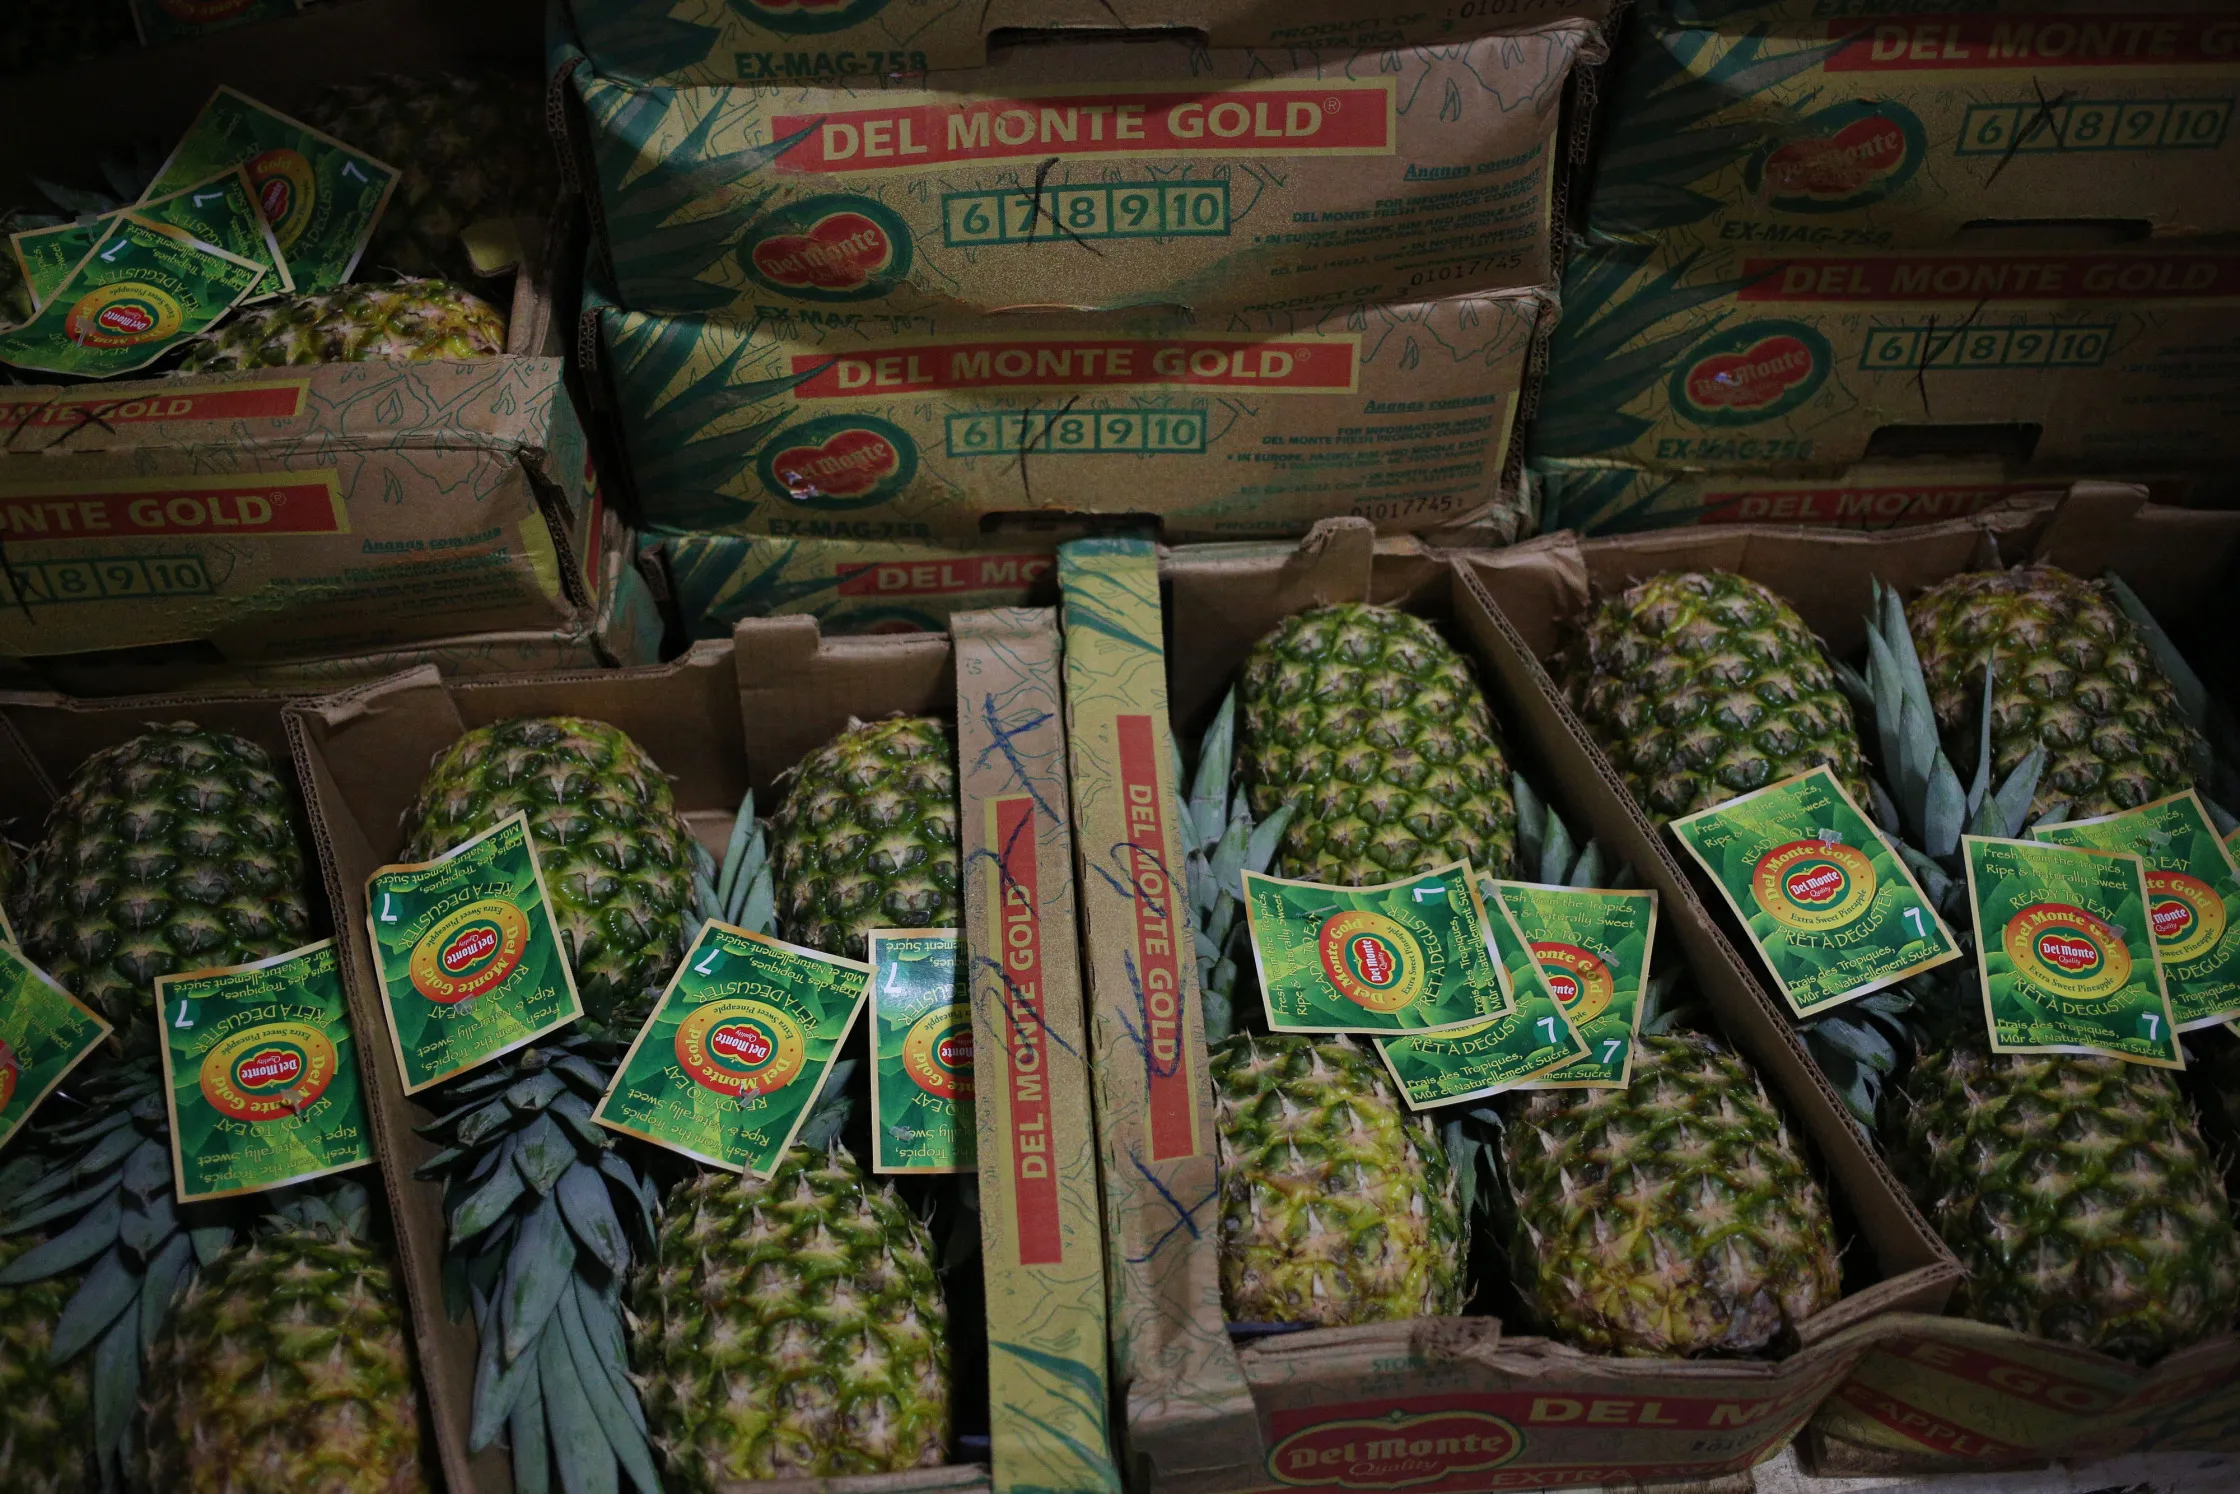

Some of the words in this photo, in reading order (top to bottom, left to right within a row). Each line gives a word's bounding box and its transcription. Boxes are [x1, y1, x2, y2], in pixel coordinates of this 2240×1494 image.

[1393, 12, 1427, 28] OF
[1870, 23, 1971, 62] DEL
[1989, 21, 2186, 58] MONTE
[735, 50, 928, 79] EX-MAG-758
[822, 118, 929, 161] DEL
[947, 103, 1146, 151] MONTE
[1978, 114, 2001, 143] 6
[2075, 112, 2102, 139] 8
[2128, 111, 2157, 140] 9
[2176, 109, 2220, 138] 10
[256, 156, 293, 175] Gold
[342, 161, 369, 184] 7
[1403, 163, 1472, 181] Ananas
[192, 191, 224, 209] 7
[962, 203, 990, 234] 6
[1015, 199, 1040, 231] 7
[1069, 196, 1097, 228] 8
[1119, 193, 1149, 226] 9
[1172, 192, 1219, 225] 10
[100, 239, 128, 262] 7
[1410, 254, 1522, 286] 01017745
[1782, 262, 1872, 295] DEL
[1890, 260, 2068, 293] MONTE
[2081, 258, 2219, 291] GOLD
[1879, 336, 1904, 362] 6
[1970, 335, 1996, 361] 8
[2016, 334, 2043, 360] 9
[2060, 334, 2102, 360] 10
[837, 355, 933, 390] DEL
[951, 347, 1135, 380] MONTE
[92, 399, 194, 420] GOLD
[1364, 400, 1425, 414] Ananas
[963, 419, 989, 447] 6
[1012, 419, 1034, 445] 7
[1059, 419, 1085, 445] 8
[1106, 419, 1133, 444] 9
[1154, 418, 1198, 445] 10
[816, 443, 888, 476] Monte
[1738, 494, 1822, 519] DEL
[362, 538, 425, 554] Ananas
[57, 568, 88, 594] 8
[106, 565, 135, 590] 9
[155, 564, 201, 589] 10
[877, 565, 965, 590] DEL
[1127, 784, 1154, 837] DEL
[1704, 833, 1733, 850] Ripe
[1795, 796, 1832, 814] Sweet
[2137, 809, 2185, 829] Tropics,
[424, 843, 487, 882] Naturellement
[1766, 844, 1815, 874] Monte
[1818, 842, 1862, 871] Gold
[2078, 860, 2126, 876] Tropics,
[375, 870, 424, 888] Sucré
[418, 866, 477, 894] Tropiques,
[1762, 873, 1780, 902] Del
[1790, 879, 1808, 896] Del
[1806, 869, 1840, 892] Monte
[2091, 877, 2129, 891] Sweet
[380, 892, 398, 922] 7
[1136, 845, 1171, 959] MONTE
[1413, 886, 1446, 903] 7
[1588, 897, 1637, 916] Tropics,
[2170, 877, 2214, 910] Gold
[1008, 883, 1034, 961] GOLD
[1331, 916, 1365, 941] Gold
[1596, 917, 1636, 929] Sweet
[1834, 886, 1893, 949] DEGUSTER
[1903, 906, 1927, 937] 7
[2015, 922, 2031, 949] Del
[2028, 909, 2086, 928] Monte
[502, 924, 519, 956] Del
[715, 931, 754, 950] Sucré
[754, 942, 834, 976] Naturellement
[885, 942, 924, 952] Sucré
[1361, 939, 1377, 968] Monte
[2042, 943, 2062, 955] Del
[2062, 944, 2096, 960] Monte
[694, 948, 720, 975] 7
[748, 957, 805, 984] Tropiques,
[1326, 942, 1356, 989] Monte
[1836, 945, 1896, 973] Tropiques,
[2058, 954, 2082, 966] Quality
[172, 978, 227, 993] Sucré
[229, 962, 297, 989] Naturellement
[418, 966, 455, 997] Gold
[457, 955, 510, 994] Monte
[884, 961, 902, 994] 7
[1796, 988, 1822, 1005] Mûr
[1834, 957, 1908, 991] Naturellement
[1908, 942, 1942, 963] Sucré
[219, 983, 286, 1001] Tropiques,
[526, 985, 556, 1004] Ripe
[1352, 984, 1387, 1005] Del
[2062, 982, 2141, 1017] DEGUSTER
[174, 999, 195, 1029] 7
[2141, 1013, 2160, 1040] 7
[715, 1032, 752, 1054] Monte
[1009, 982, 1043, 1104] MONTE
[1536, 1015, 1559, 1044] 7
[2054, 1022, 2120, 1040] Tropiques,
[416, 1034, 456, 1058] Sweet
[751, 1041, 768, 1059] Del
[1602, 1039, 1622, 1065] 7
[2044, 1033, 2128, 1051] Naturellement
[2130, 1041, 2166, 1058] Sucré
[241, 1061, 279, 1081] Monte
[420, 1048, 472, 1072] Tropics,
[702, 1066, 759, 1090] Monte
[763, 1054, 794, 1088] Del
[912, 1049, 945, 1087] Gold
[1413, 1086, 1438, 1102] Mûr
[1454, 1059, 1535, 1093] Naturellement
[1535, 1045, 1571, 1068] Sucré
[1460, 1050, 1524, 1074] Tropiques,
[210, 1073, 245, 1111] Gold
[627, 1088, 668, 1107] Sweet
[196, 1154, 240, 1167] Sweet
[895, 1143, 949, 1158] Tropics,
[1019, 1117, 1049, 1182] DEL
[1528, 1396, 1679, 1425] DEL
[1288, 1442, 1357, 1470] Del
[1367, 1433, 1504, 1461] Monte
[1349, 1459, 1440, 1477] Quality
[1490, 1468, 1632, 1487] EXTRA
